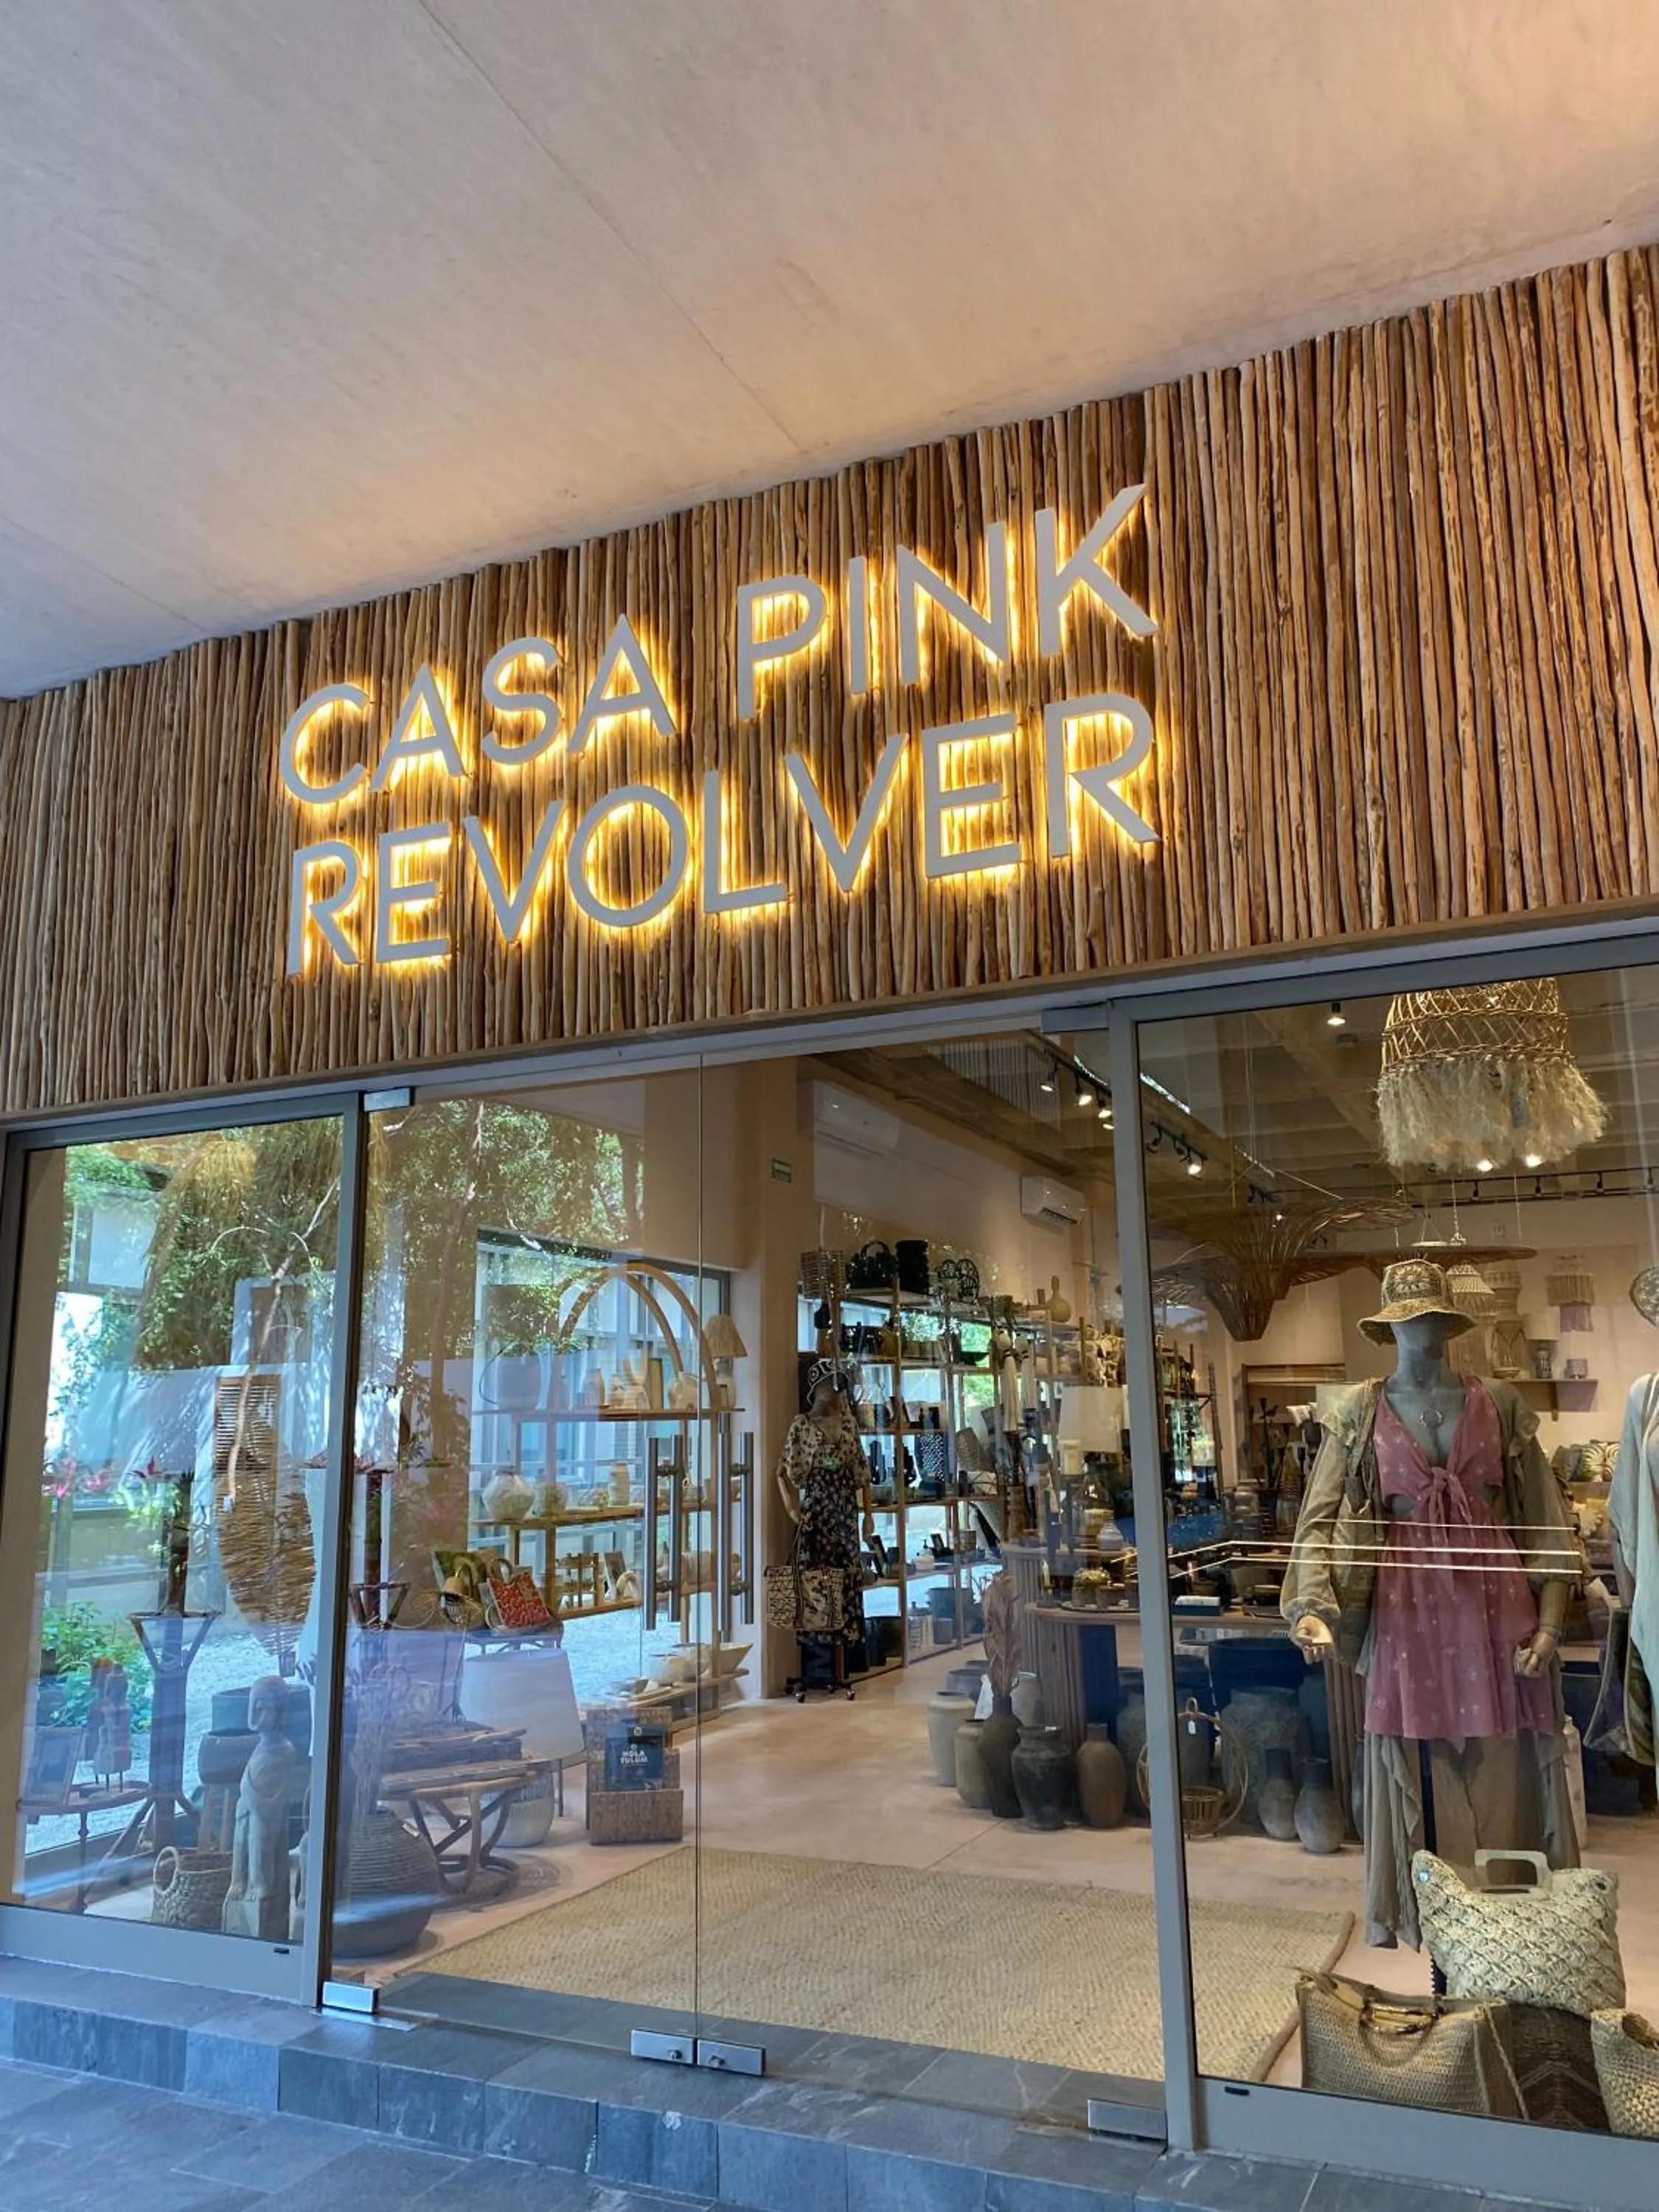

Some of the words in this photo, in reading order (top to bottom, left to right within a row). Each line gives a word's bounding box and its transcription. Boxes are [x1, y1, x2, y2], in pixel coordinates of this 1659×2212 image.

[279, 613, 676, 804] CASA
[737, 484, 1157, 719] PINK
[287, 693, 1158, 975] REVOLVER
